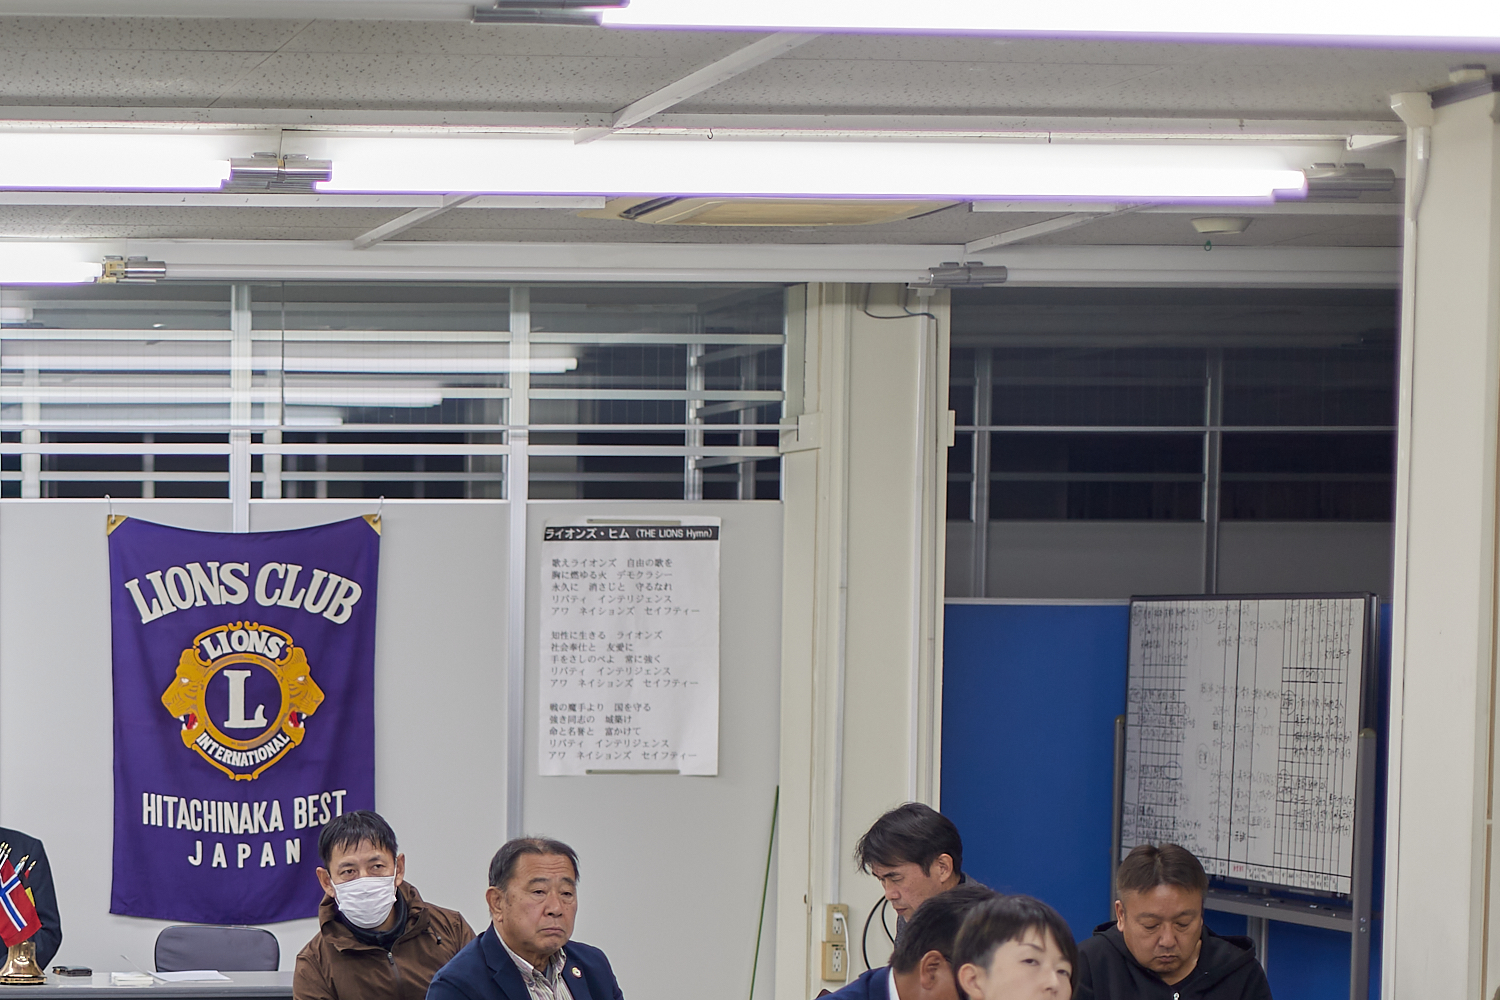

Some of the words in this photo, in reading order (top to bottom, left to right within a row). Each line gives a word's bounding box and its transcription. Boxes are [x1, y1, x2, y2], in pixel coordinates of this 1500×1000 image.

[545, 527, 630, 540] ライオンズ・ヒム
[658, 528, 684, 539] LIONS
[617, 570, 673, 579] デモクラシー
[125, 561, 250, 625] LIONS
[254, 561, 362, 625] CLUB
[598, 594, 672, 604] インテリジェンス
[552, 607, 569, 615] アワ
[579, 606, 635, 616] ネイションズ
[644, 607, 700, 615] セイフティー
[551, 631, 606, 640] 知性に生きる
[617, 631, 663, 640] ライオンズ
[199, 628, 286, 661] LIONS
[597, 667, 671, 675] インテリジェンス
[550, 679, 568, 688] アワ
[578, 678, 634, 688] ネイションズ
[643, 679, 699, 688] セイフティー
[223, 669, 268, 729] L
[595, 739, 669, 748] インテリジェンス
[194, 731, 291, 768] INTERNATIONAL
[549, 751, 566, 760] アワ
[577, 751, 631, 760] ネイションズ
[641, 750, 697, 761] セイフティー
[142, 792, 285, 835] HITACHINAKA
[293, 789, 348, 831] BEST
[187, 837, 302, 870] JAPAN
